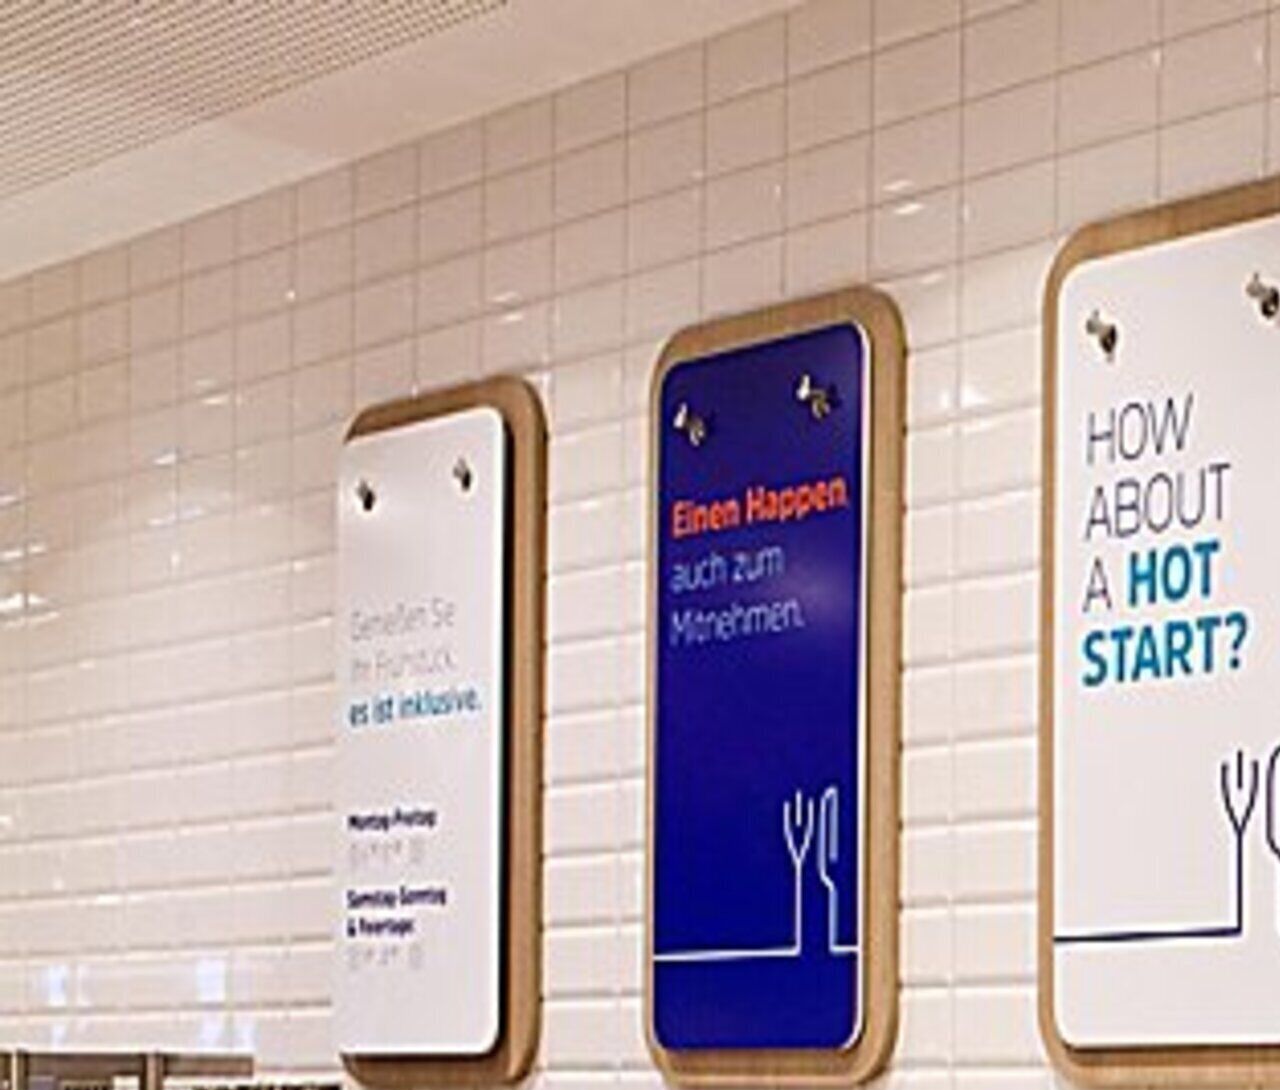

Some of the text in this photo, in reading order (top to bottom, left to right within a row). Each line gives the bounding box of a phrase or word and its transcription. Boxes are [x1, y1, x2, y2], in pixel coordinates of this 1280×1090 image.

[1086, 393, 1194, 465] HOW
[672, 498, 740, 540] Einen
[1086, 463, 1231, 540] ABOUT
[670, 546, 786, 594] auch zum
[1083, 538, 1221, 613] A HOT
[1082, 612, 1248, 687] START?
[349, 702, 368, 727] es
[373, 695, 394, 724] ist
